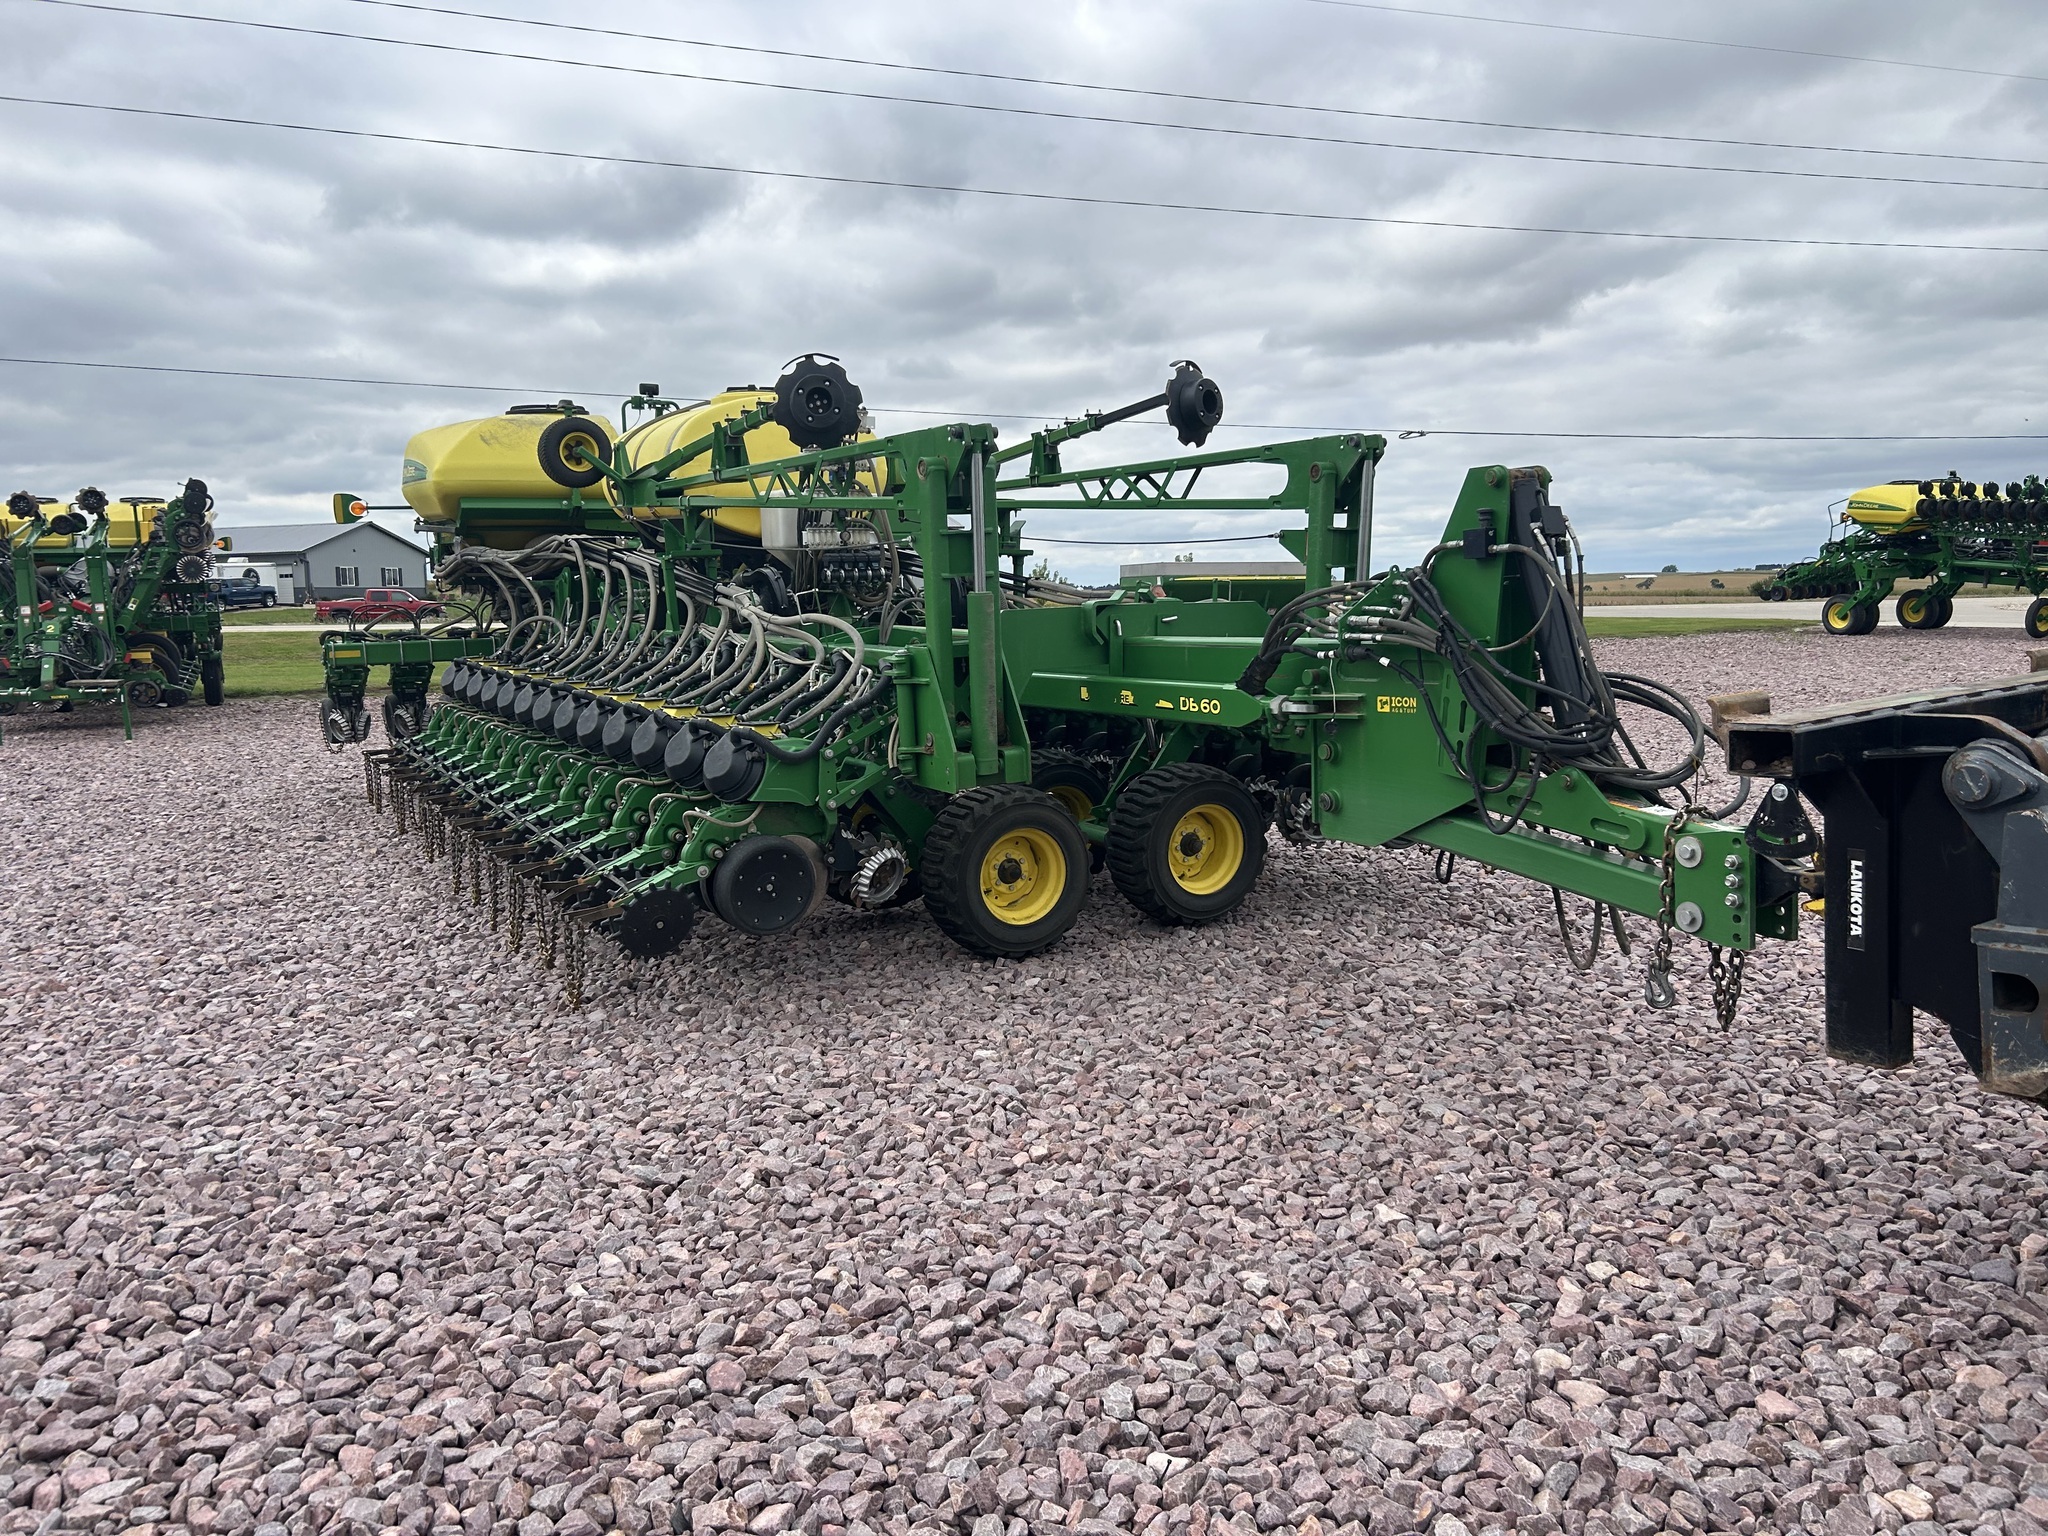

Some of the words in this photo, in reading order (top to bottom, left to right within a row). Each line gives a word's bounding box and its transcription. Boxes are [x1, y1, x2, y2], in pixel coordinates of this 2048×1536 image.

[46, 625, 55, 633] 2
[1391, 697, 1417, 708] ICON
[1850, 860, 1863, 936] LANKOTA
